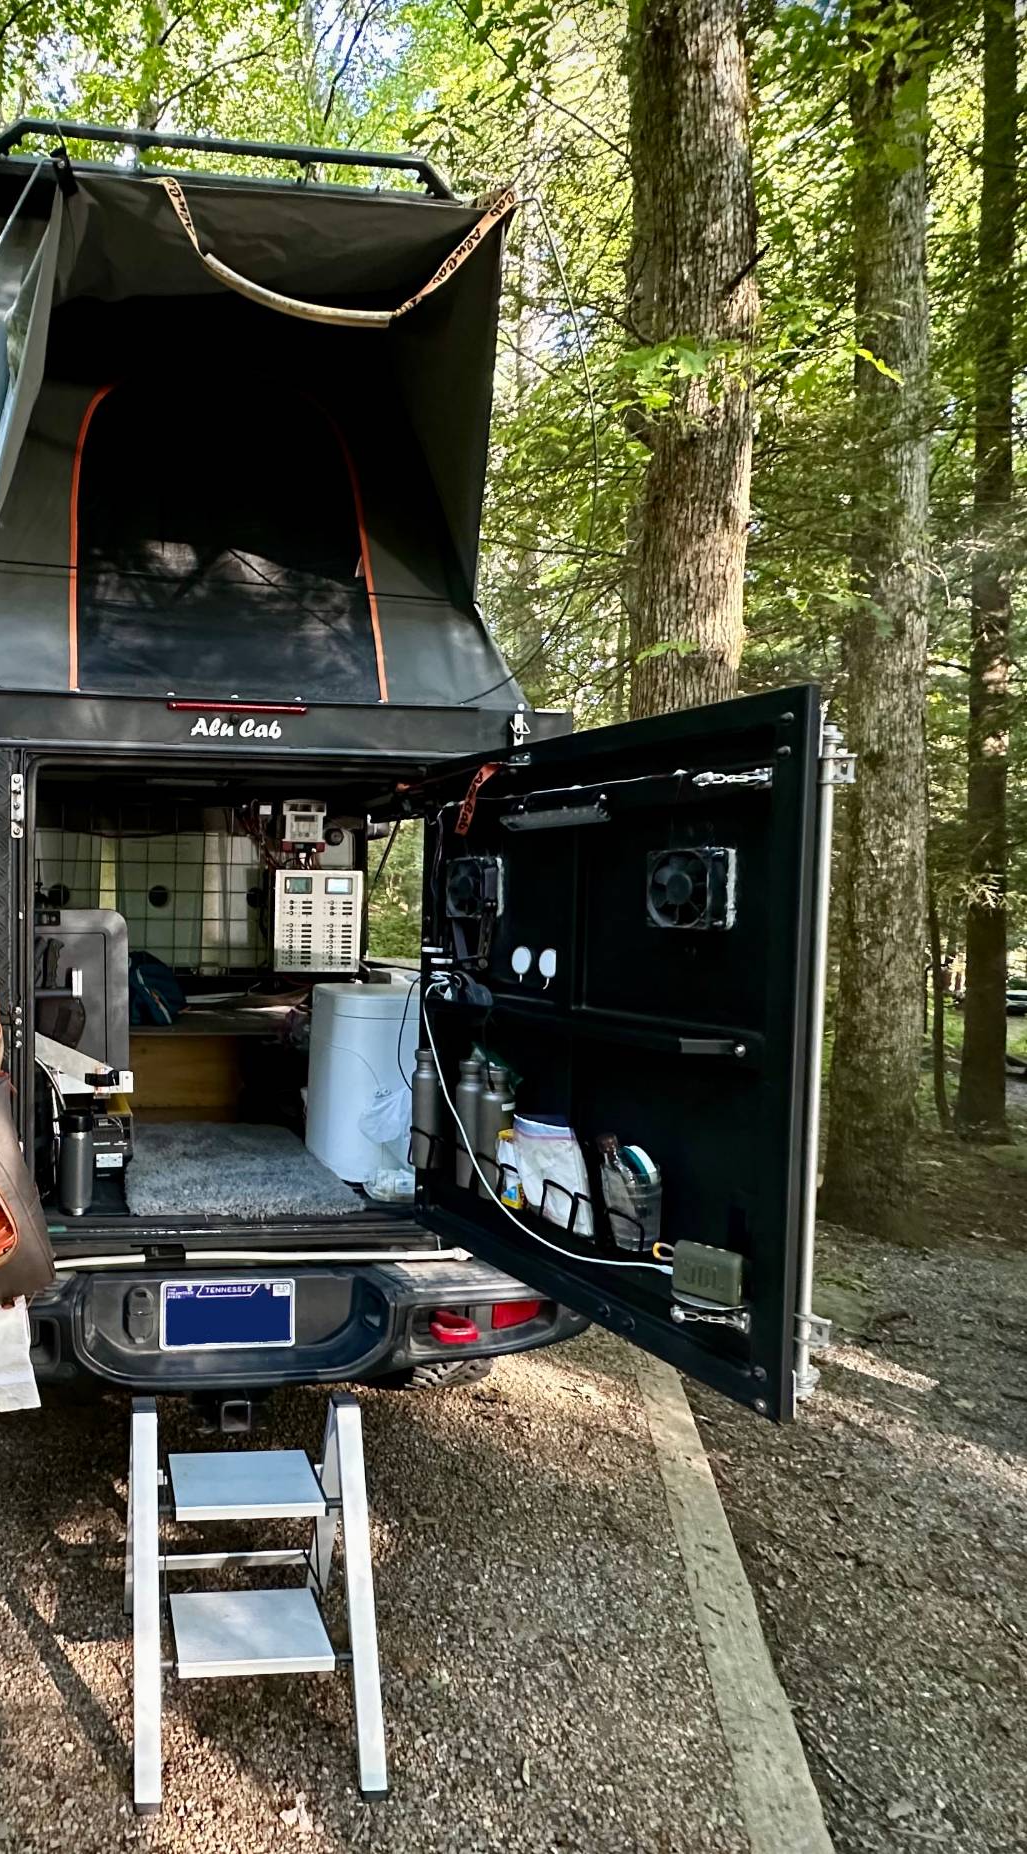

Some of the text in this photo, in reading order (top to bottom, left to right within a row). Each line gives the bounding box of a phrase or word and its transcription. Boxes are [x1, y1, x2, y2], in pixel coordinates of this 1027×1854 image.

[432, 228, 482, 284] Alu-Cab
[190, 717, 283, 741] Alu Cab
[682, 1258, 724, 1291] JBL
[204, 1285, 252, 1294] TENNESSEE
